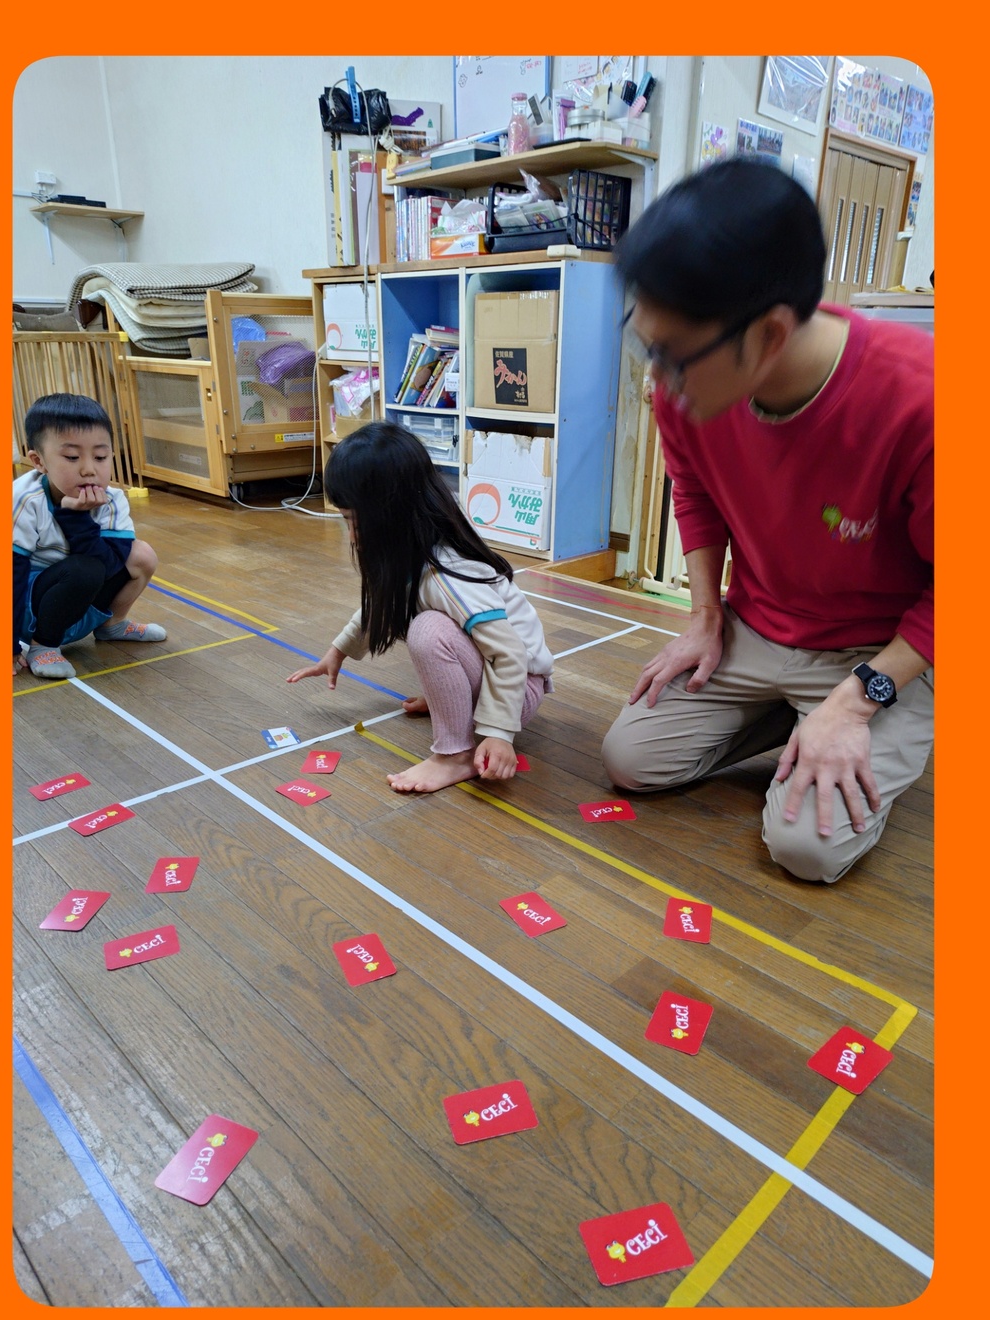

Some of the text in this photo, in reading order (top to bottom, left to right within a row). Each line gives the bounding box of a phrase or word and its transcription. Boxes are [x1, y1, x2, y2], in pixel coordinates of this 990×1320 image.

[494, 359, 527, 388] みかん
[508, 493, 542, 512] みかん
